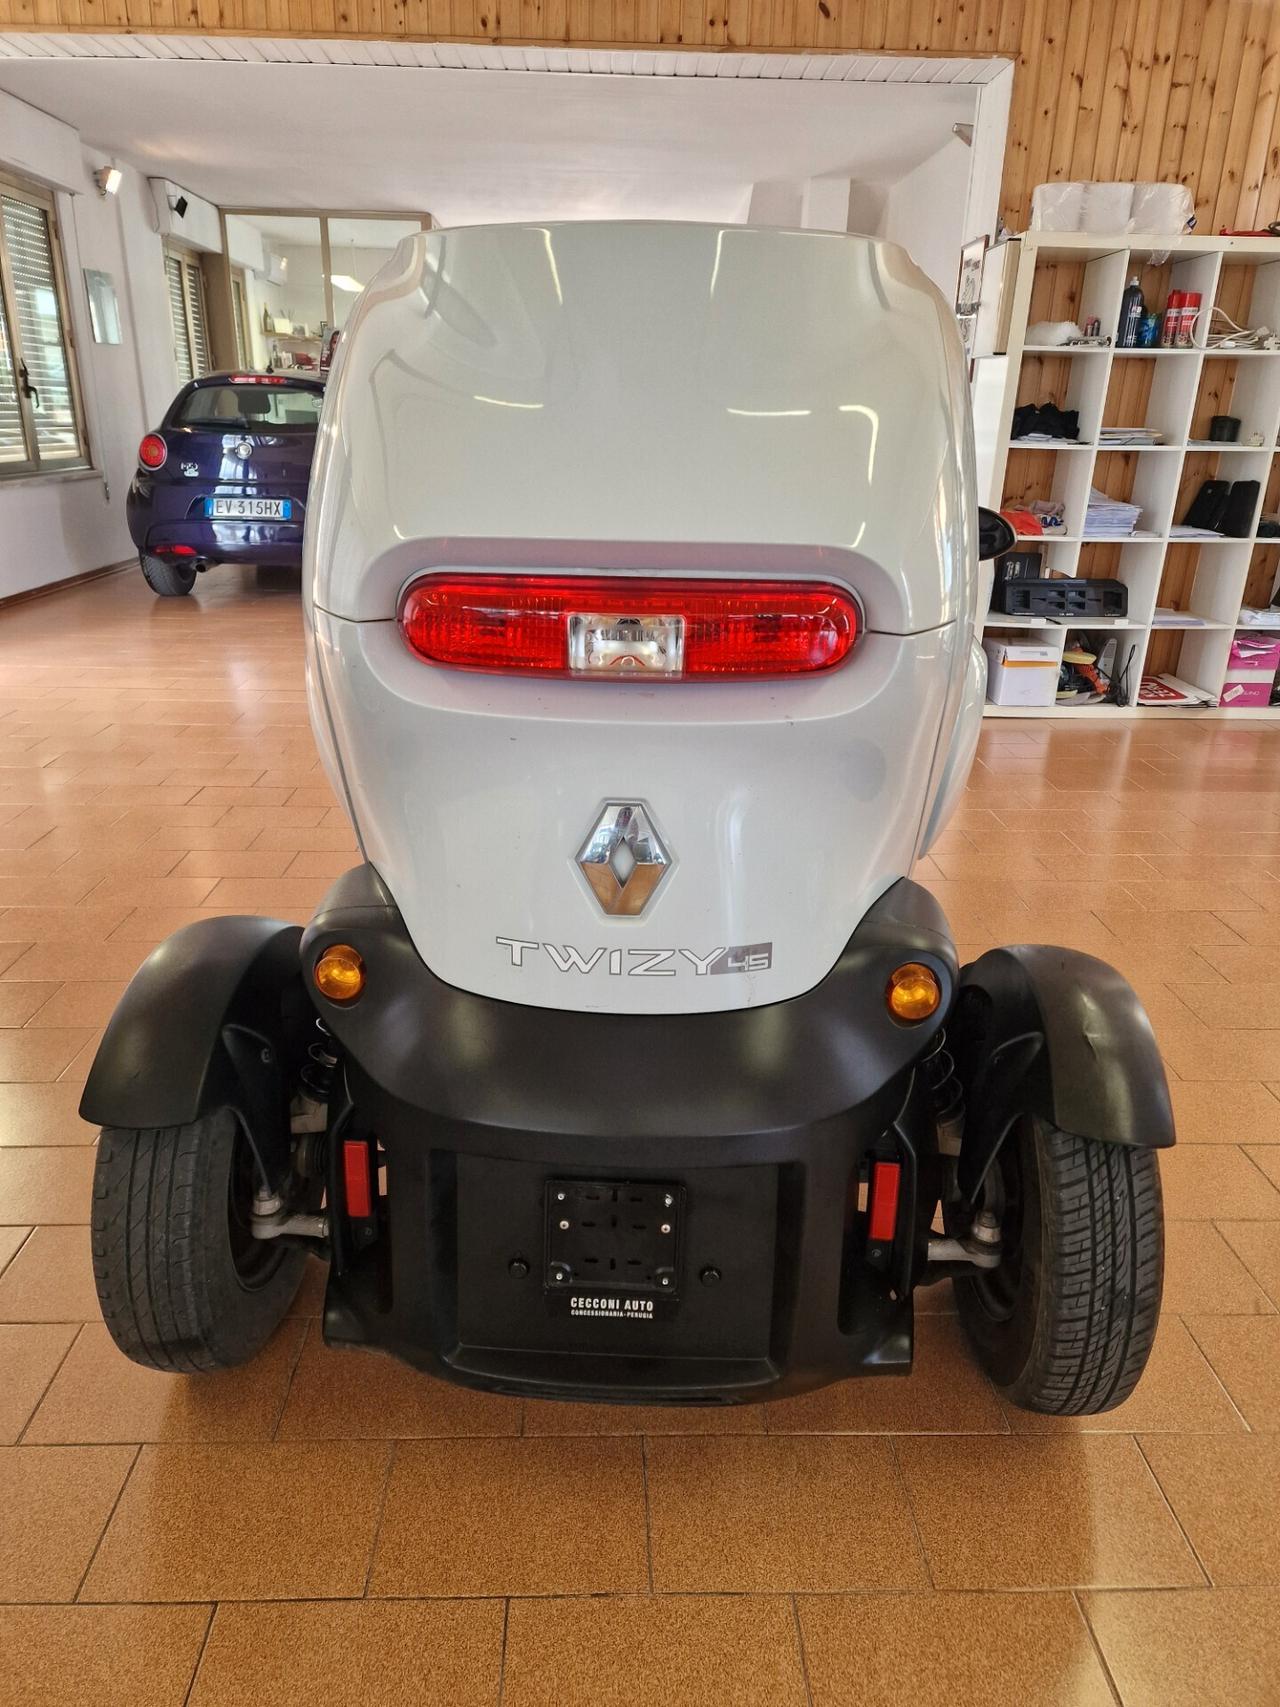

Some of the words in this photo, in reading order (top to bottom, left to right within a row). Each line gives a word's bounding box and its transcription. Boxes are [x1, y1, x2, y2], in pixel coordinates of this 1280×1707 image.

[216, 500, 232, 514] EV
[237, 500, 281, 516] 315HX
[496, 936, 727, 976] TWIZY
[728, 952, 769, 971] 45
[570, 1297, 620, 1310] CECCONI
[624, 1300, 654, 1312] AUTO
